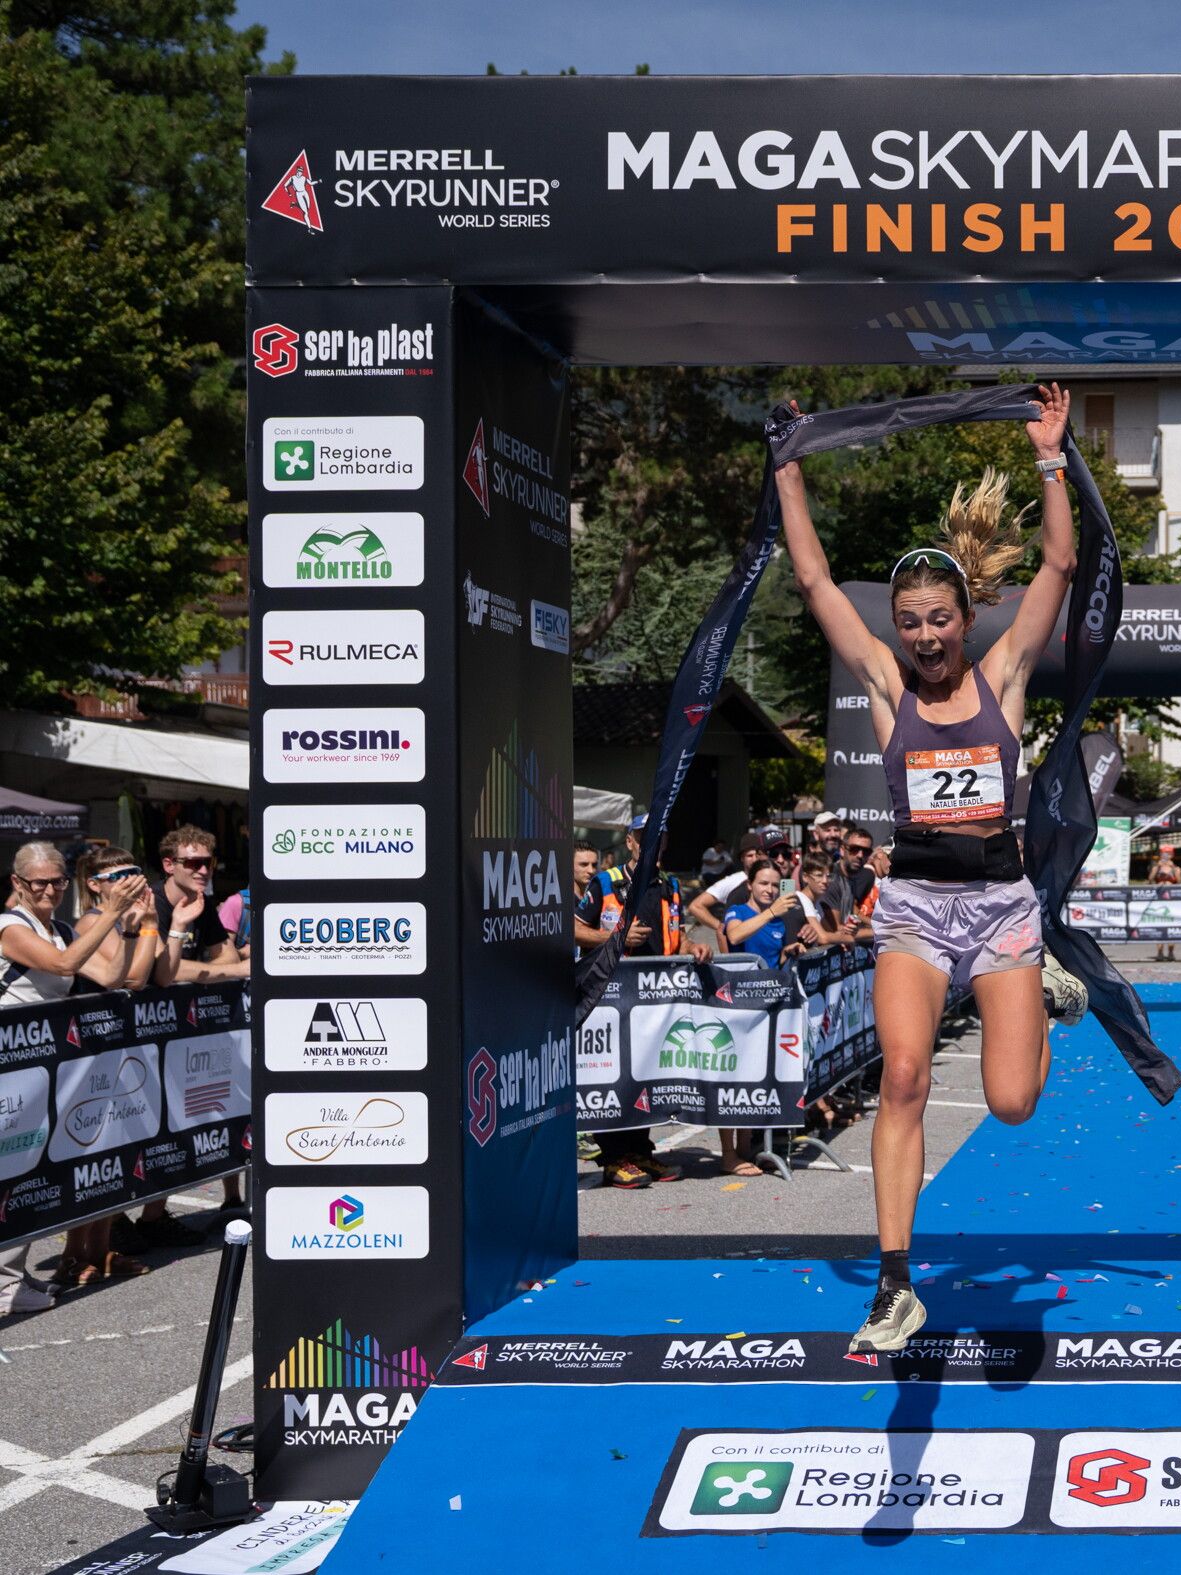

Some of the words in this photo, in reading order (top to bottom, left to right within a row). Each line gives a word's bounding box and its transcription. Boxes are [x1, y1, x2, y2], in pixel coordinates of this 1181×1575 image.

[334, 150, 505, 171] MERRELL
[438, 214, 495, 228] WORLD
[499, 214, 551, 228] SERIES
[777, 203, 1065, 252] FINISH
[320, 446, 392, 462] Regione
[320, 462, 413, 475] Lombardia
[297, 561, 392, 579] MONTELLO
[1085, 534, 1117, 631] RECCO
[283, 754, 303, 762] Your
[307, 754, 350, 762] workwear
[354, 754, 378, 762] since
[381, 753, 400, 761] 1969
[935, 751, 972, 762] MAGA
[932, 768, 980, 801] 22
[930, 800, 957, 809] NATALIE
[959, 797, 984, 806] BEADLE
[951, 810, 967, 818] SOS
[301, 828, 413, 836] FONDAZIONE
[301, 842, 335, 854] BCC
[345, 841, 413, 853] MILANO
[483, 850, 562, 910] MAGA
[280, 918, 412, 943] GEOBERG
[483, 911, 562, 943] SKYMARATHON
[638, 971, 703, 990] MAGA
[134, 1000, 177, 1026] MAGA
[303, 1047, 338, 1056] ANDREA
[342, 1047, 388, 1056] MONGUZZI
[312, 1058, 381, 1066] FABBRO
[717, 1088, 780, 1106] MAGA
[320, 1108, 350, 1123] Villa
[718, 1106, 781, 1115] SKYMARATHON
[74, 1156, 124, 1190] MAGA
[75, 1180, 124, 1202] SKYMARATHON
[291, 1234, 402, 1249] MAZZOLENI
[664, 1339, 806, 1358] MAGA
[661, 1358, 805, 1369] SKYMARATHON
[284, 1393, 417, 1427] MAGA
[712, 1446, 748, 1455] Con
[754, 1446, 765, 1455] il
[770, 1445, 861, 1455] contributo
[867, 1445, 885, 1454] di
[802, 1469, 962, 1490] Regione
[795, 1489, 1003, 1507] Lombardia
